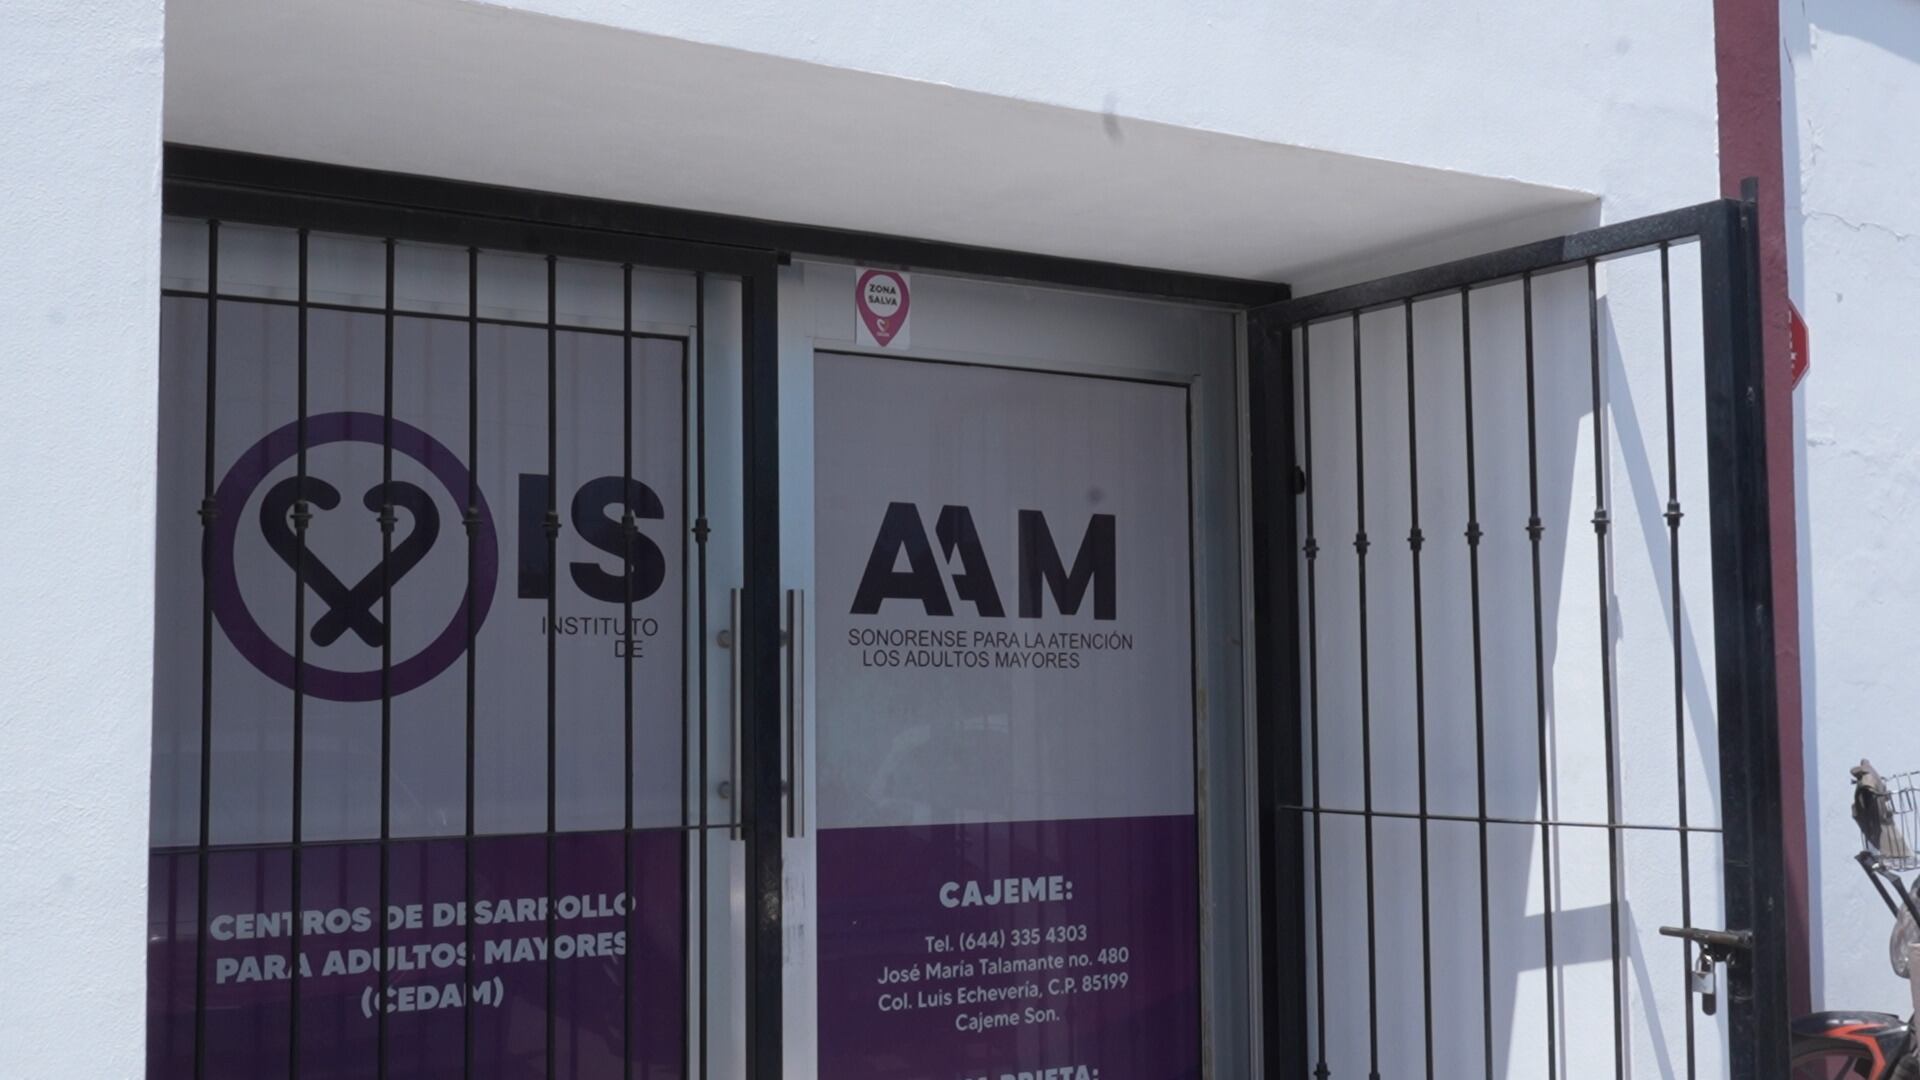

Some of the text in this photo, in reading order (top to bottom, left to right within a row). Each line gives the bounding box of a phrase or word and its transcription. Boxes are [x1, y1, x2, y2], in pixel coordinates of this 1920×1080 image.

[869, 296, 897, 305] SALVA
[870, 284, 896, 294] ZONA
[518, 473, 666, 603] IS
[849, 502, 1116, 620] AAM
[614, 640, 644, 658] DE
[848, 628, 1133, 650] SONORENSE PARA LA ATENCIÓN
[863, 649, 1080, 669] LOS ADULTOS MAYORES
[940, 875, 1073, 909] CAJEME:
[210, 907, 372, 941] CENTROS
[387, 903, 423, 931] DE
[925, 925, 1088, 954] Tel. (644) 335 4303
[216, 931, 627, 984] PARA ADULTOS MAYORES
[878, 947, 1130, 984] José María Talamante no. 480
[361, 976, 504, 1019] (CEDAM)
[878, 972, 1129, 1012] Col. Luis Echevería, C.P. 85199
[955, 1007, 1060, 1033] Cajeme Son.
